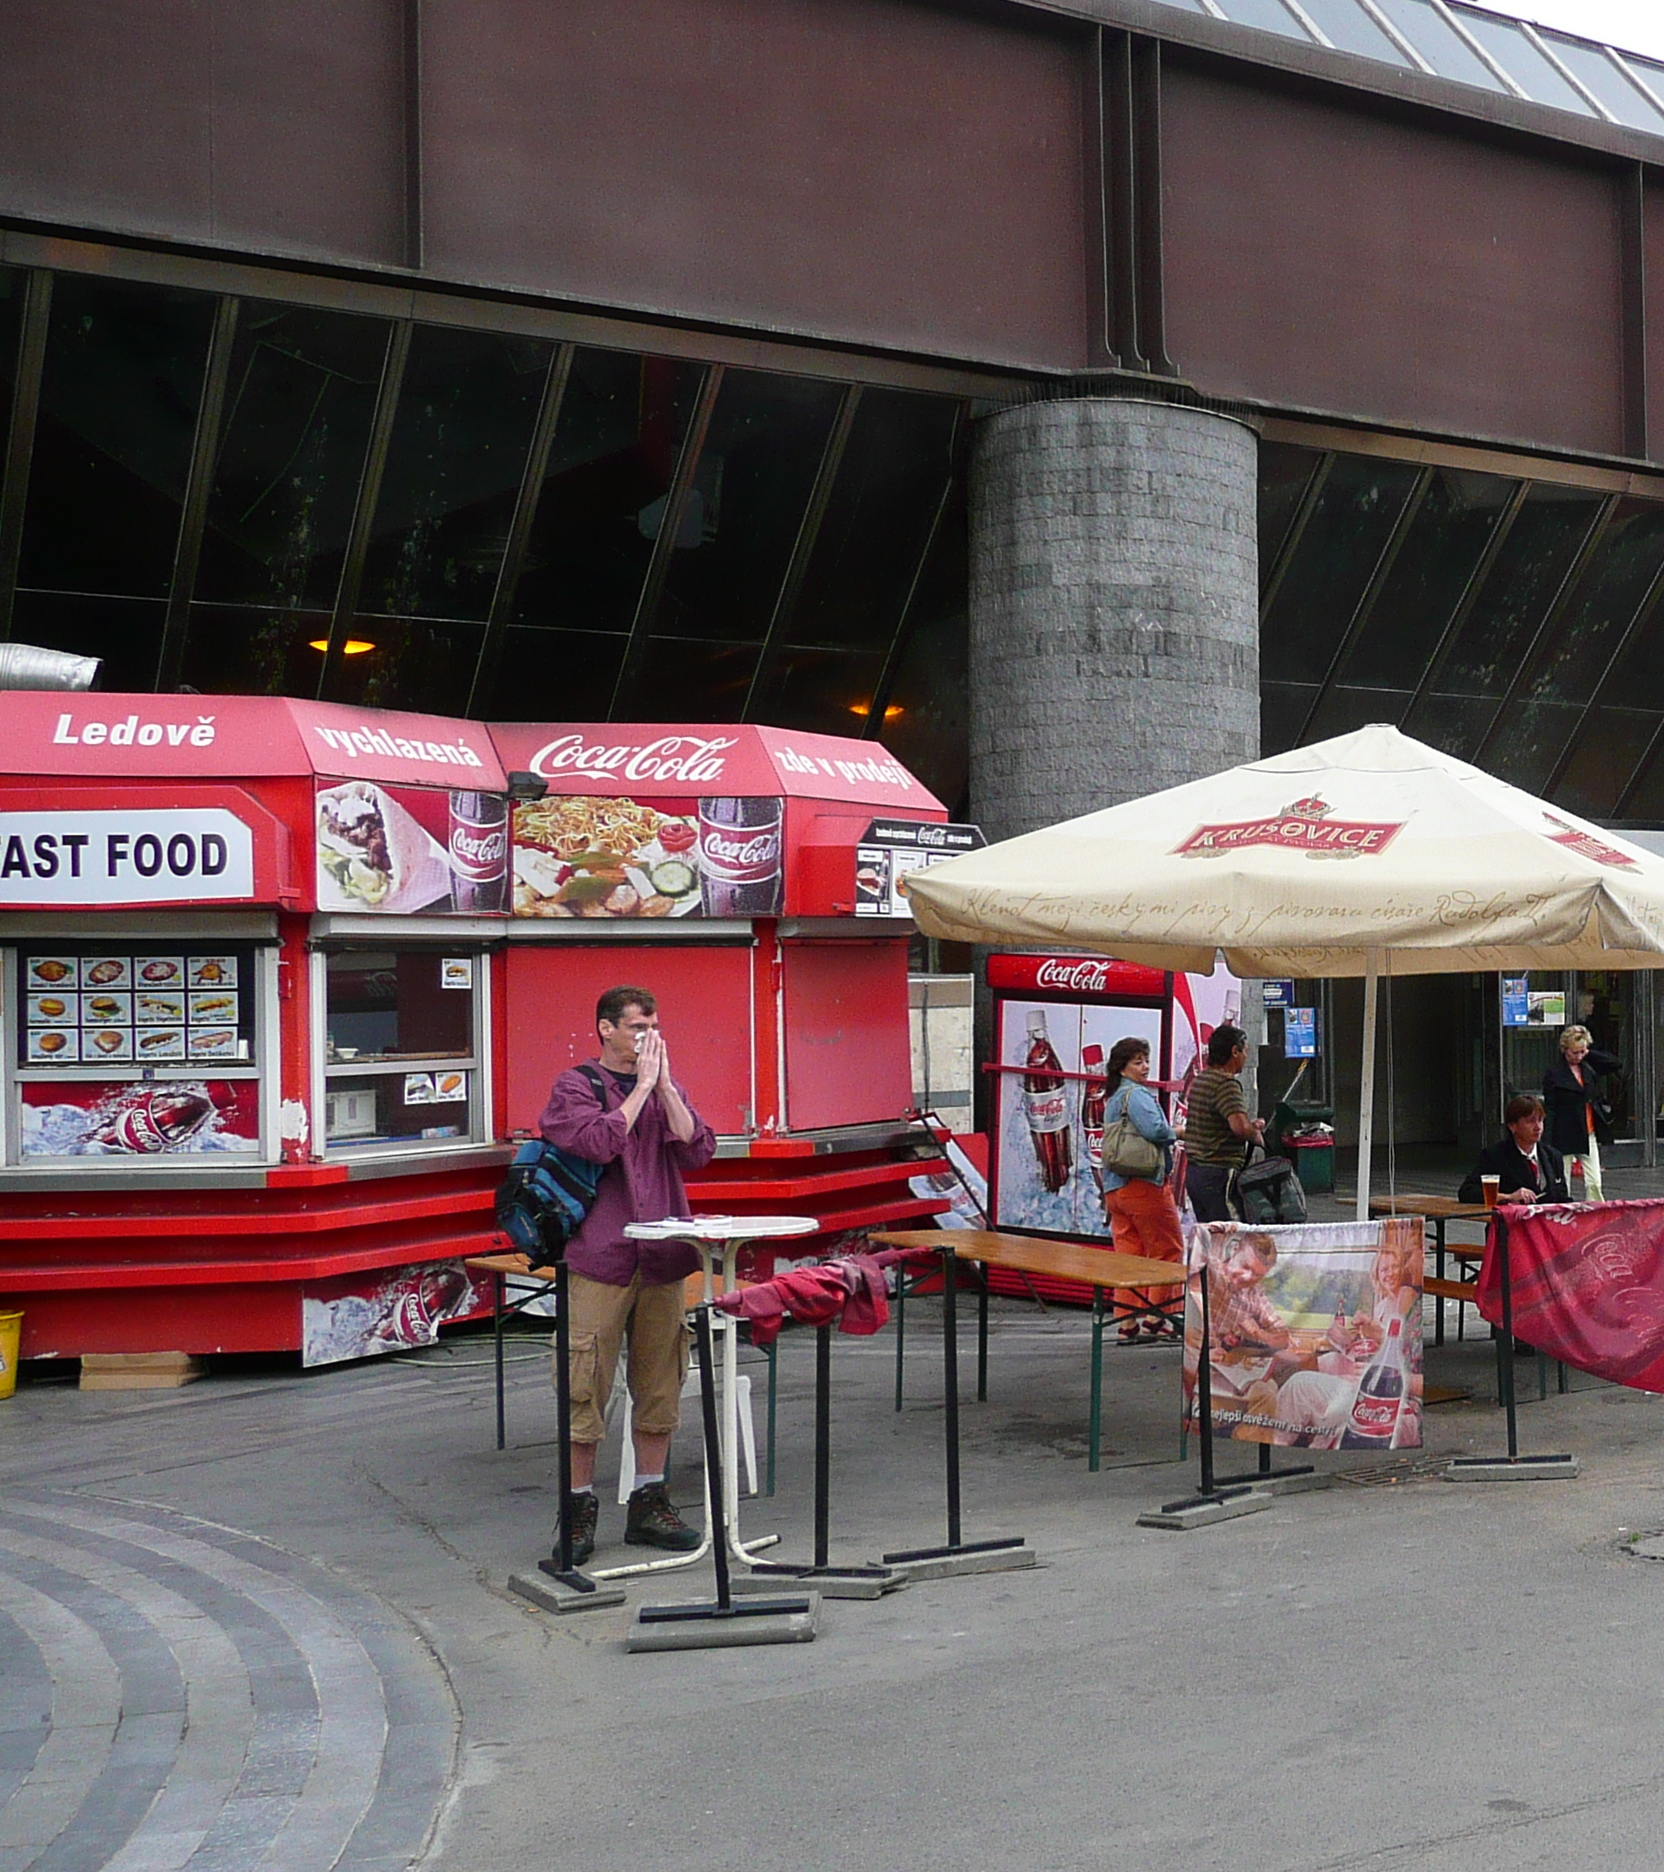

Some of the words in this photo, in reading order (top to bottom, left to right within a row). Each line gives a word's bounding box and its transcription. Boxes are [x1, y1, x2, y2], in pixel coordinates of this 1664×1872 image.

[53, 714, 216, 747] Ledově
[314, 725, 483, 768] vychlazená
[529, 734, 739, 781] Coca-Cola
[775, 747, 814, 777] zde
[819, 758, 836, 779] v
[704, 832, 778, 864] Coca-Cola
[1191, 819, 1385, 847] KRUŠOVICE
[0, 833, 89, 878] AST
[107, 833, 228, 877] FOOD
[1037, 959, 1112, 991] Coca-Cola
[1354, 1403, 1397, 1424] Coca-Cola
